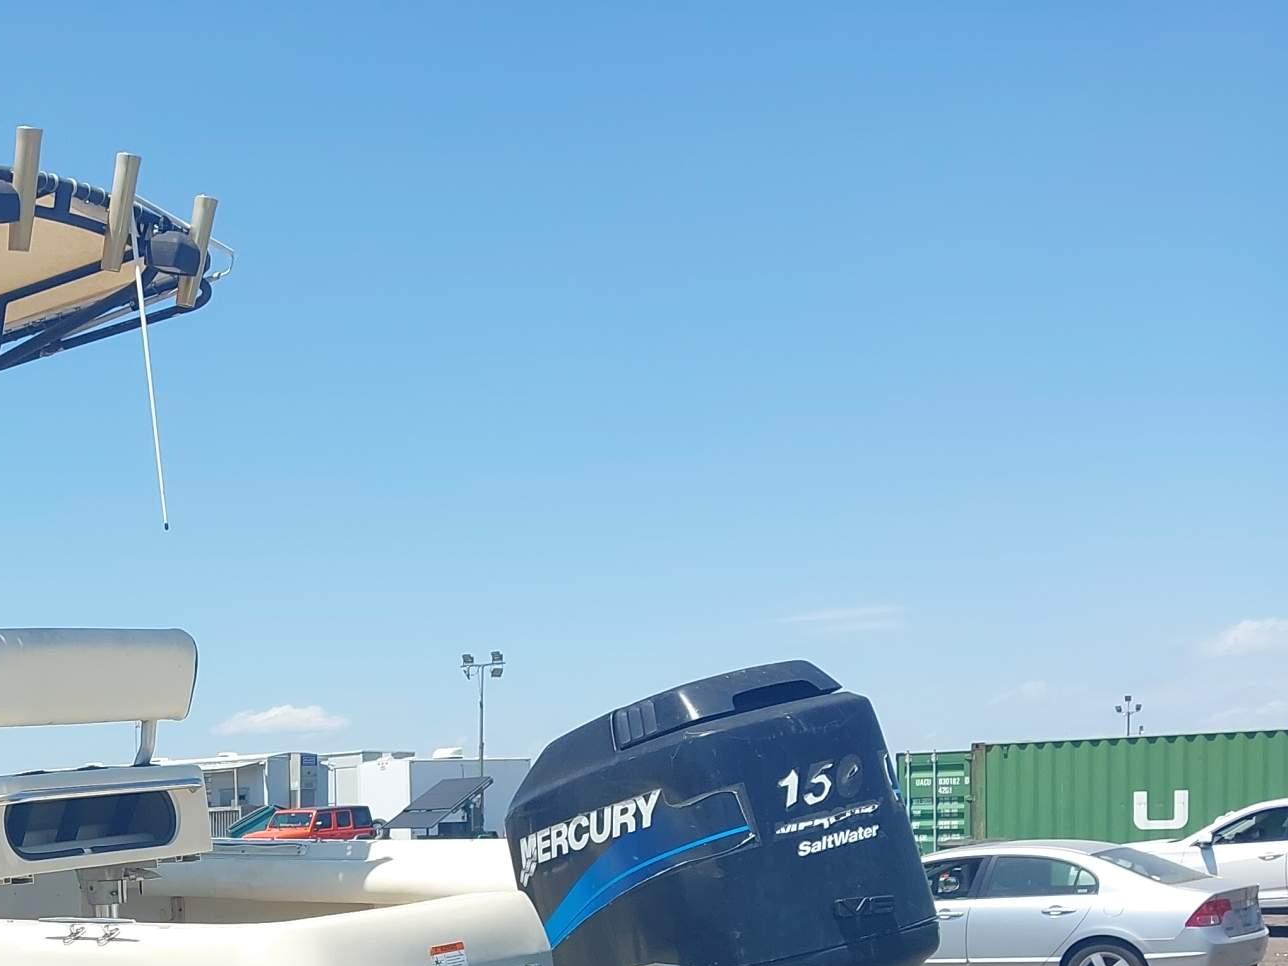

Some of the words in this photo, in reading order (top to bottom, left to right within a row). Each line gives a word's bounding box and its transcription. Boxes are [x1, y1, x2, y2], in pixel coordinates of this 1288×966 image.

[1133, 790, 1189, 830] U
[519, 788, 662, 887] MERCURY
[798, 824, 880, 857] SaltWater
